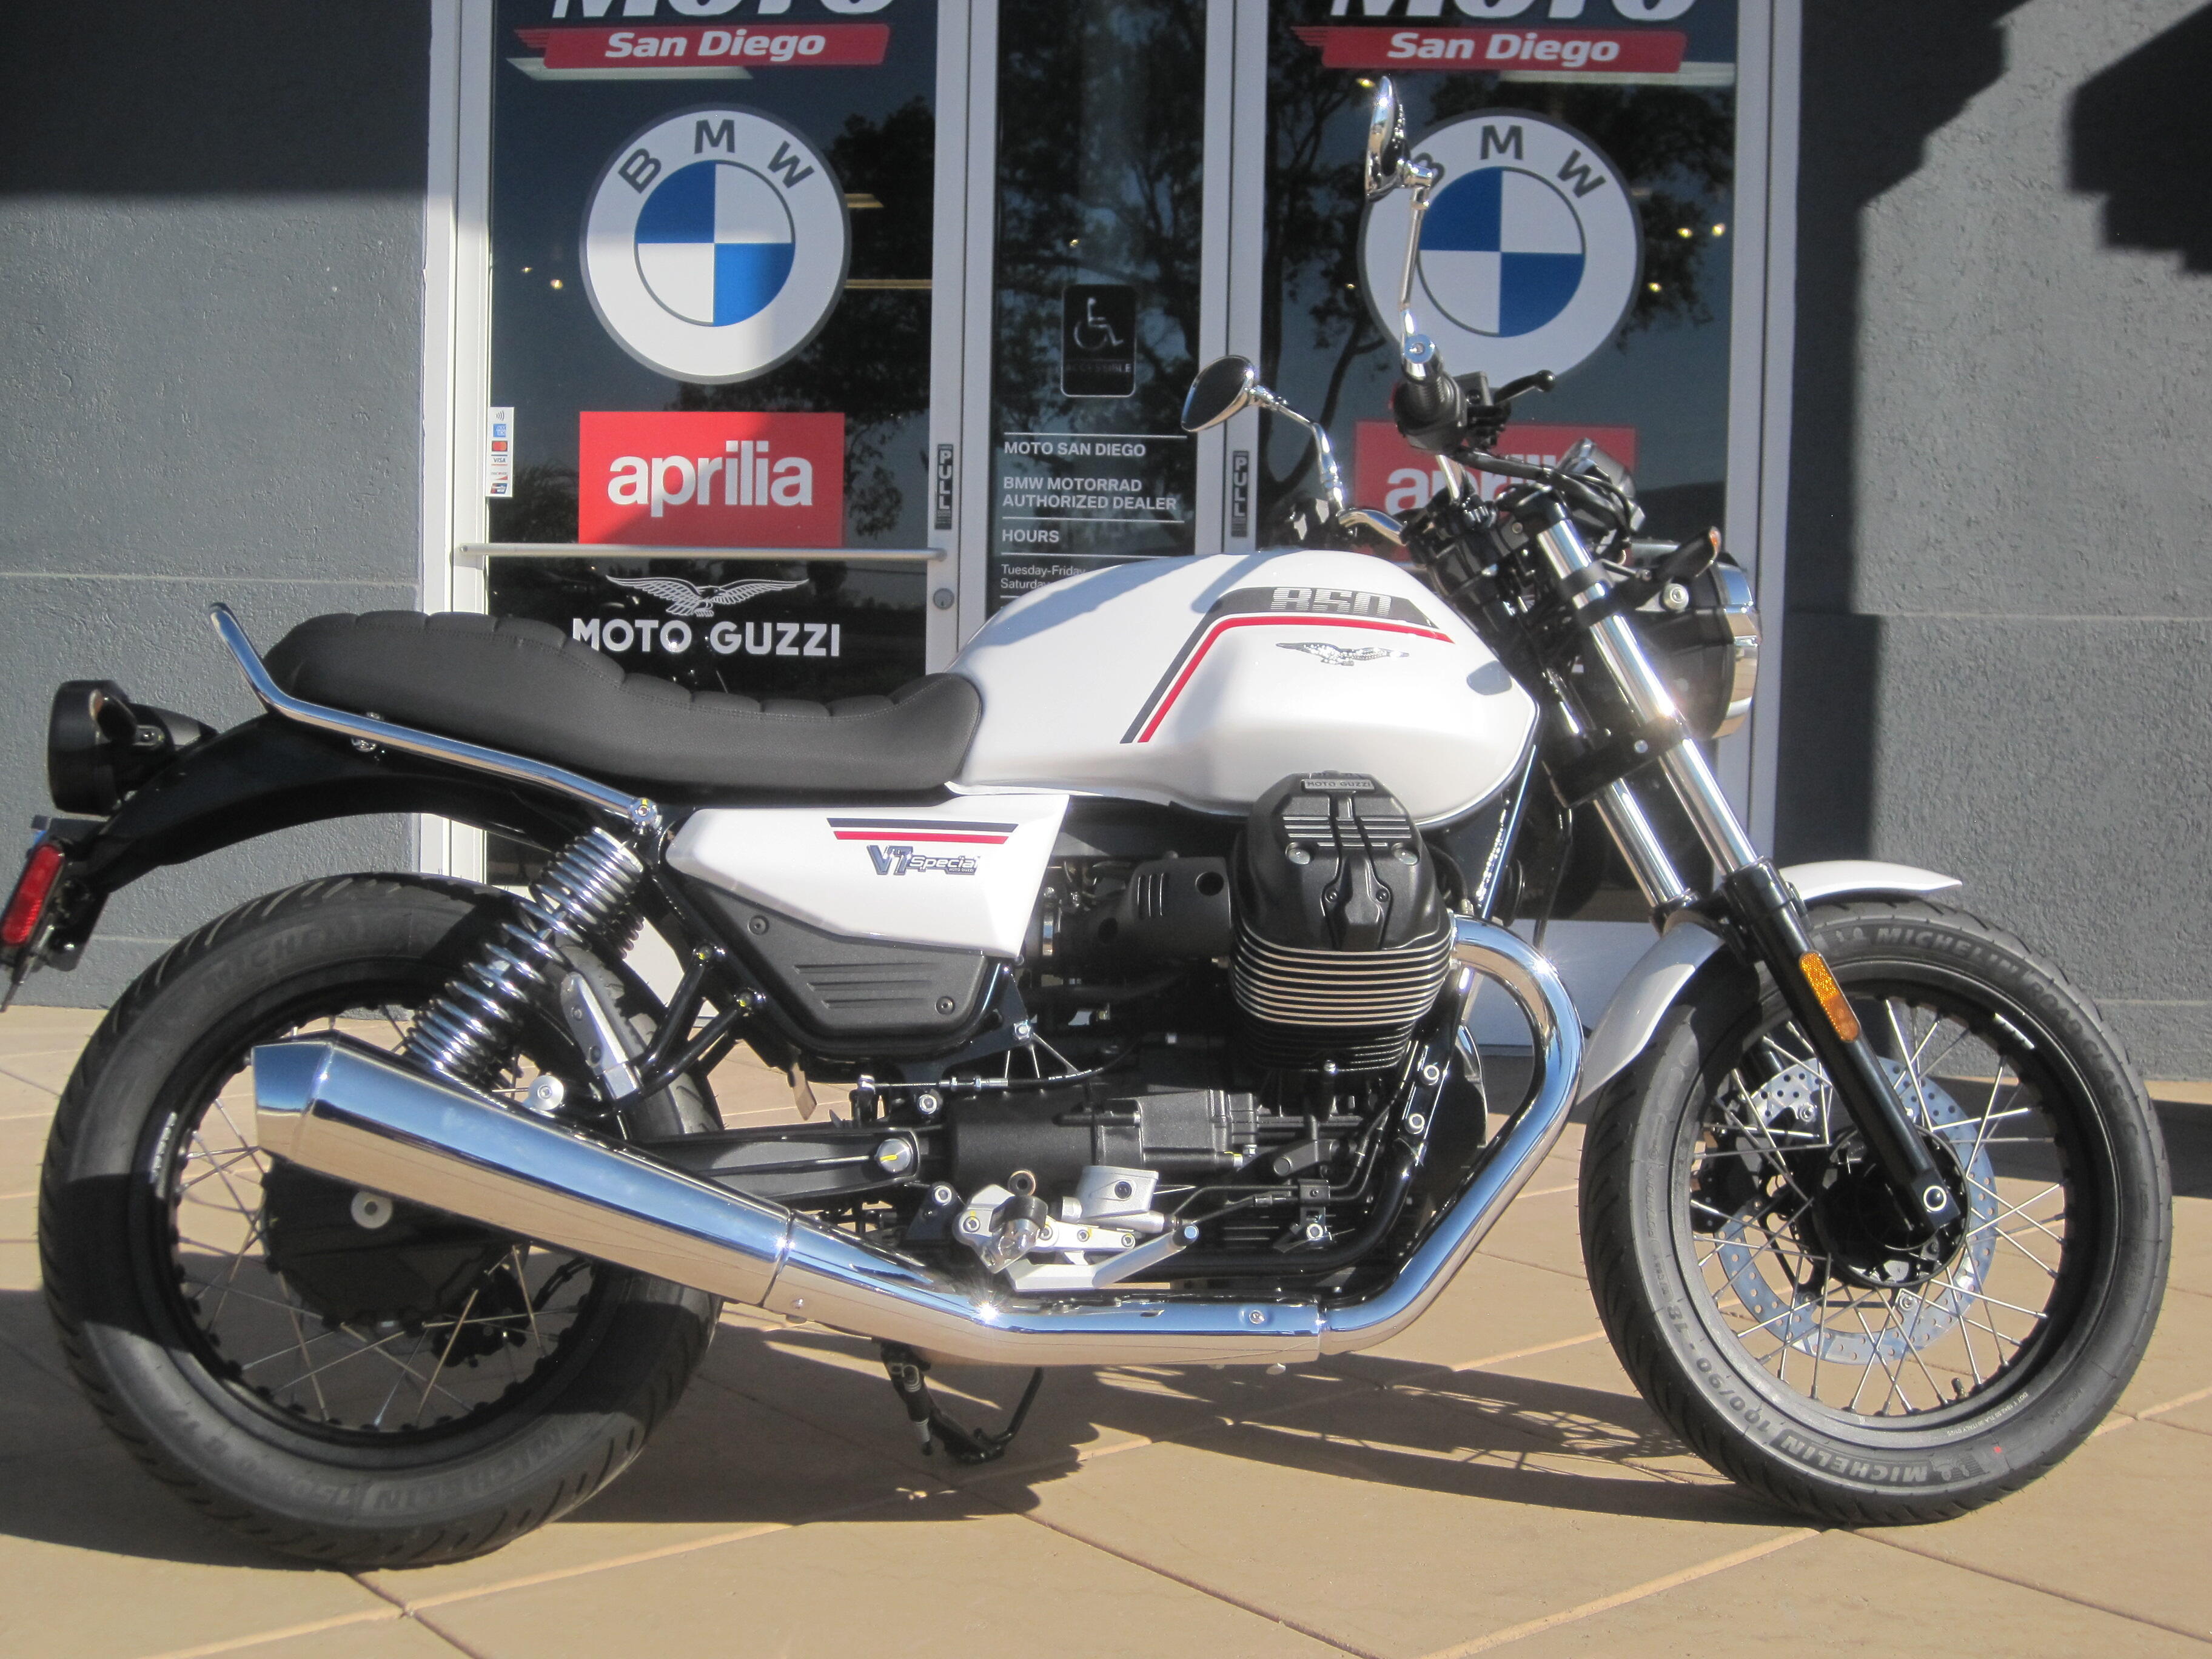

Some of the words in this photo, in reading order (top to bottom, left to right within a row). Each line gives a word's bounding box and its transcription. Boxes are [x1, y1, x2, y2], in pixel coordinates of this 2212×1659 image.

[605, 32, 688, 57] San
[697, 29, 826, 62] Diego
[1387, 32, 1475, 59] San
[1486, 33, 1620, 67] Diego
[618, 119, 815, 194] BMW
[1004, 441, 1053, 455] MOTO
[1057, 443, 1091, 455] SAN
[1095, 443, 1147, 457] DIEGO
[607, 440, 813, 517] aprilia
[938, 449, 953, 510] PULL
[1003, 477, 1044, 490] BMW
[1047, 477, 1142, 492] MOTORRAD
[1233, 457, 1247, 517] PULL
[1002, 494, 1108, 509] AUTHORIZED
[1113, 496, 1177, 510] DEALER
[1002, 529, 1060, 543] HOURS
[1270, 587, 1393, 617] 850
[572, 618, 692, 654] MOTO
[709, 621, 840, 657] GUZZI
[866, 845, 914, 876] V7
[909, 855, 980, 871] Special
[1877, 927, 2020, 974] MICHELIN
[1669, 1305, 1687, 1333] 18
[1697, 1357, 1771, 1432] 100/90
[1781, 1435, 1928, 1483] MICHELIN
